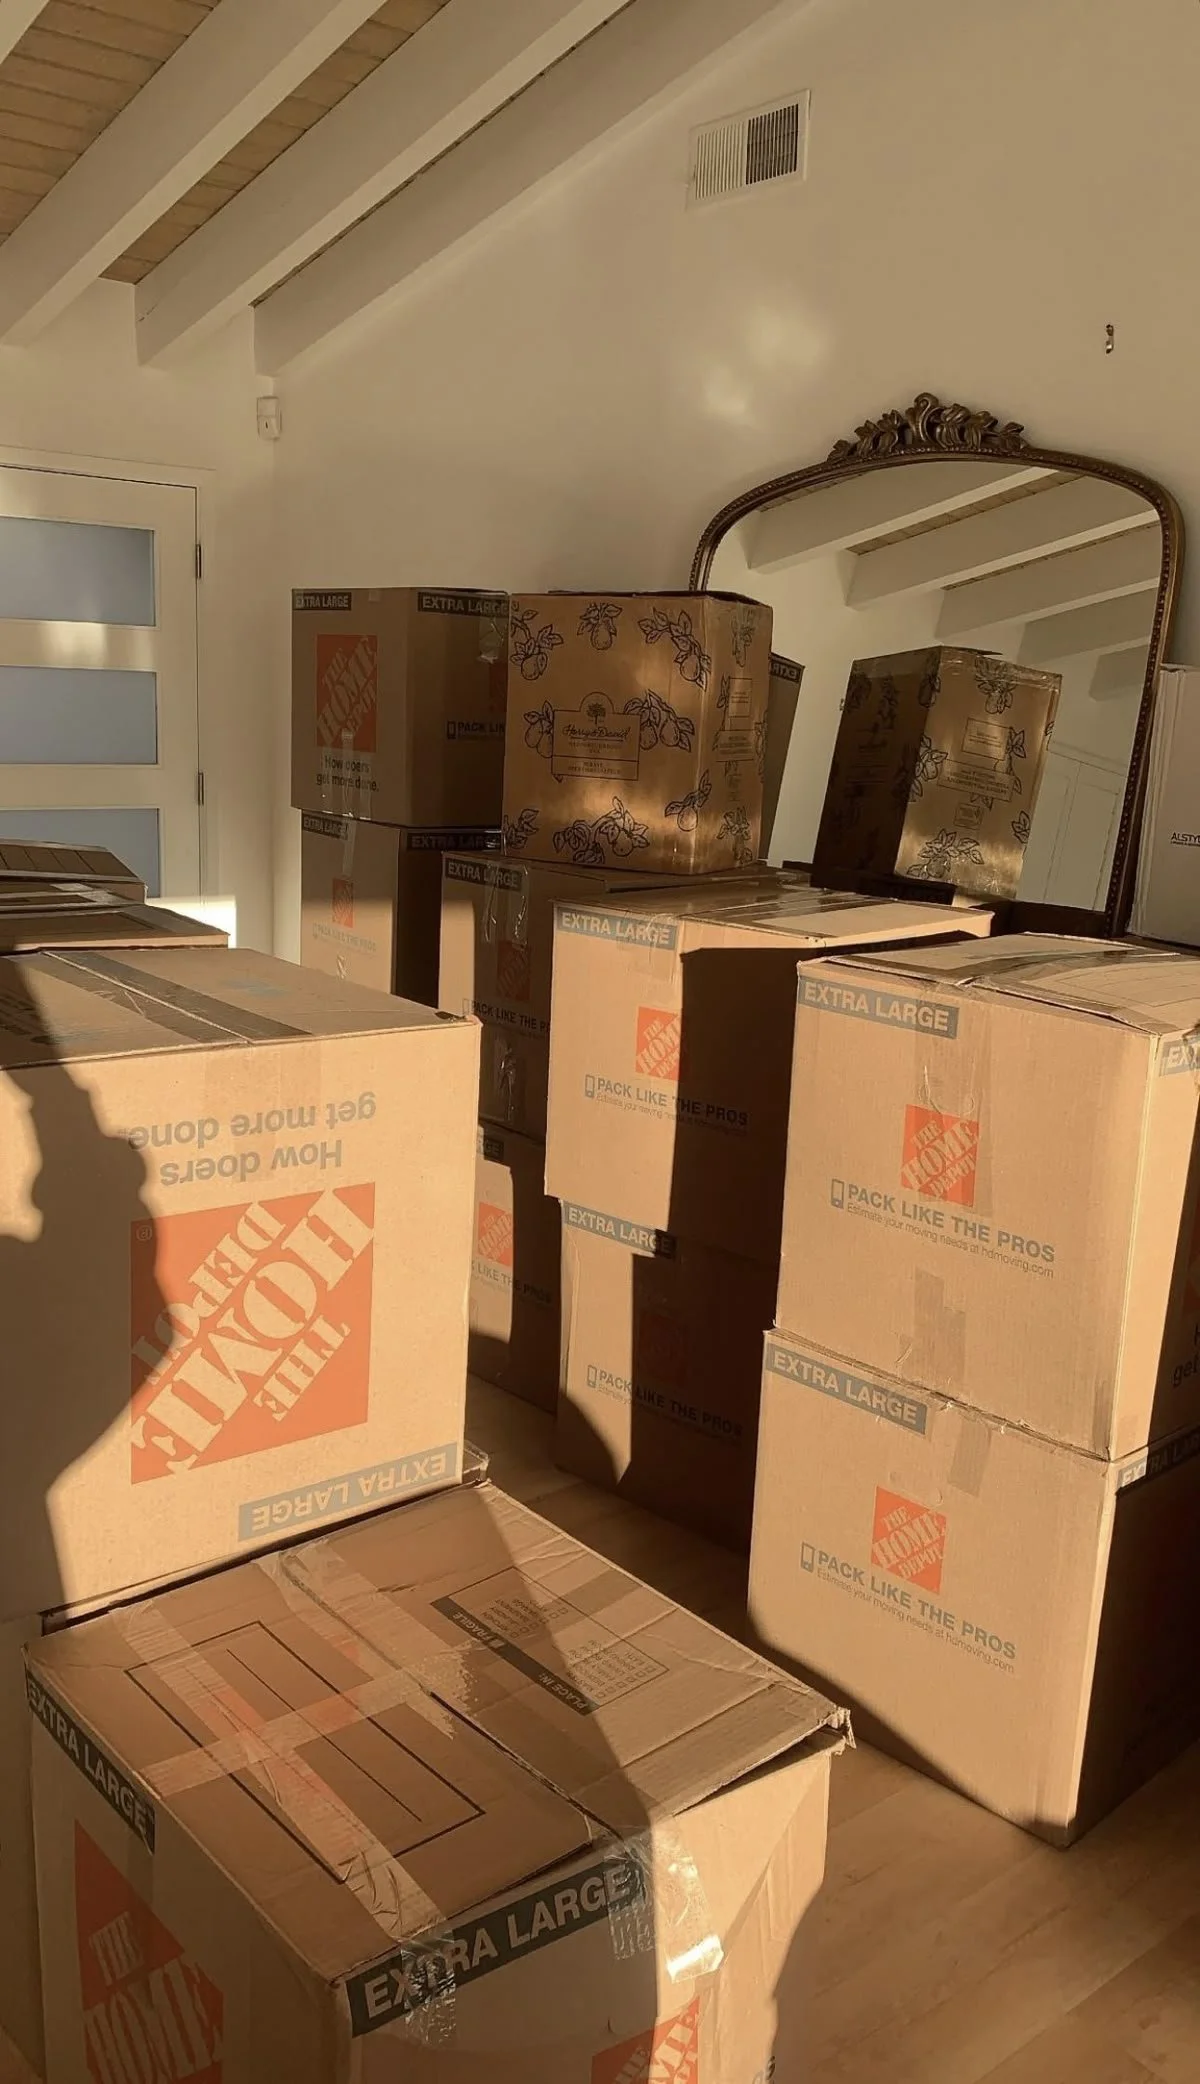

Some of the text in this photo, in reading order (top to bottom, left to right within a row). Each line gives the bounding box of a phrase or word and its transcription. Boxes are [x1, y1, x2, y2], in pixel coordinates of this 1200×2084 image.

[295, 595, 349, 609] EXTRA LARGE
[421, 597, 508, 616] EXTRA LARGE
[317, 638, 377, 745] HOME
[325, 755, 344, 769] How
[412, 835, 456, 848] EXTRA
[448, 861, 518, 888] EXTRA LARGE
[562, 912, 670, 945] EXTRA LARGE
[496, 1008, 517, 1024] LIKE
[519, 1015, 537, 1030] THE
[804, 984, 949, 1032] EXTRA LARGE
[636, 1014, 682, 1074] HOM
[231, 1105, 318, 1136] more
[327, 1092, 376, 1129] get
[597, 1077, 632, 1099] PACK
[636, 1087, 669, 1108] LIKE
[705, 1104, 750, 1127] PROS
[901, 1119, 977, 1191] HOME
[913, 1120, 943, 1150] THE
[160, 1140, 341, 1187] How doers
[930, 1154, 975, 1198] DEPOT
[569, 1207, 673, 1253] EXTRA LARGE
[847, 1202, 882, 1223] Estimate
[883, 1216, 904, 1232] your
[905, 1224, 938, 1244] moving
[939, 1232, 968, 1251] needs
[968, 1240, 979, 1254] at
[848, 1183, 1055, 1263] PACK LIKE THE PROS
[132, 1203, 288, 1384] DEPOT
[478, 1262, 500, 1282] LIKE
[131, 1189, 374, 1474] HOME
[254, 1315, 351, 1422] THE
[773, 1349, 918, 1425] EXTRA LARGE
[600, 1369, 743, 1437] PACK LIKE THE PROS
[252, 1450, 448, 1532] EXTRA LARGE
[871, 1511, 945, 1572] HOME
[882, 1504, 912, 1533] THE
[898, 1546, 943, 1580] DEPOT
[452, 1610, 493, 1641] FRAGILE
[818, 1550, 1016, 1660] PACK LIKE THE PROS
[853, 1585, 873, 1602] your
[873, 1596, 904, 1622] moving
[906, 1614, 934, 1635] needs
[551, 1681, 588, 1709] PLACE
[29, 1682, 149, 1835] EXTRA LARGE
[507, 1863, 627, 1950] LARGE
[89, 1910, 144, 1987] THE
